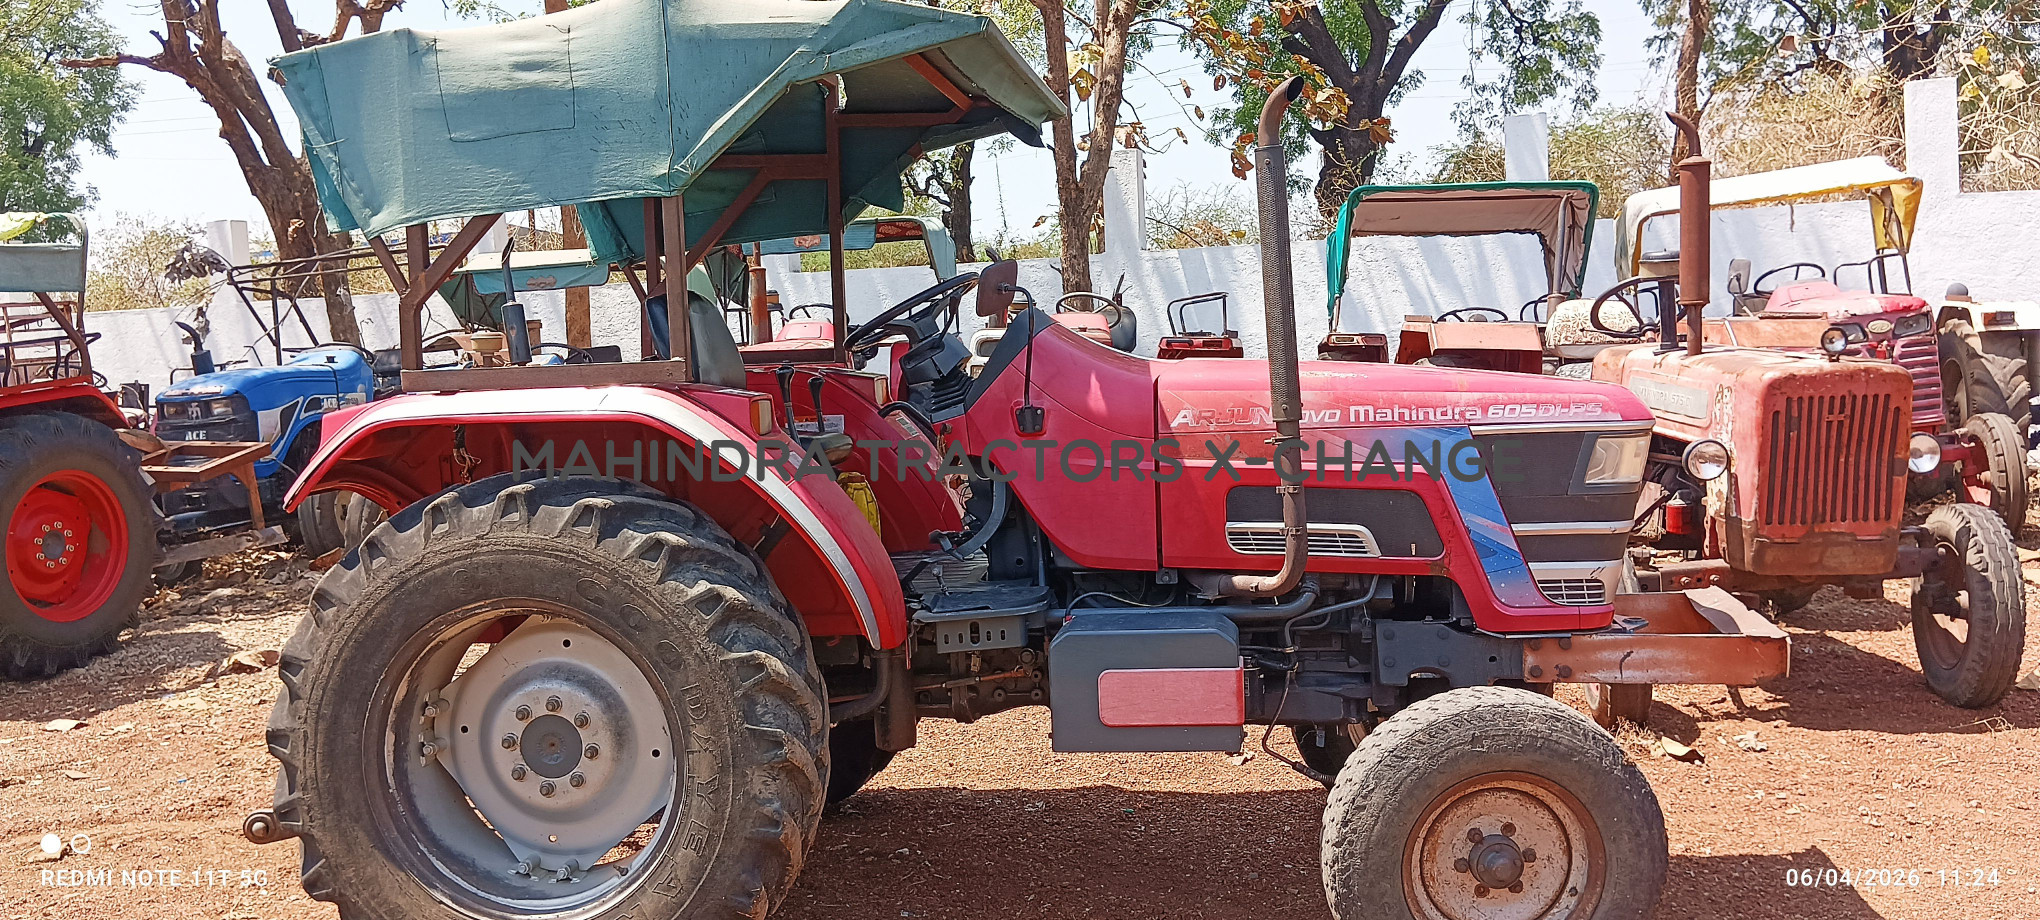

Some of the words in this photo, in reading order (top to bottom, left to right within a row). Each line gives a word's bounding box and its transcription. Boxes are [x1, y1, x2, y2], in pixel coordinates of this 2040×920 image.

[1170, 407, 1274, 428] ARJUN
[1350, 405, 1482, 423] Mahindra
[185, 430, 207, 441] ACE
